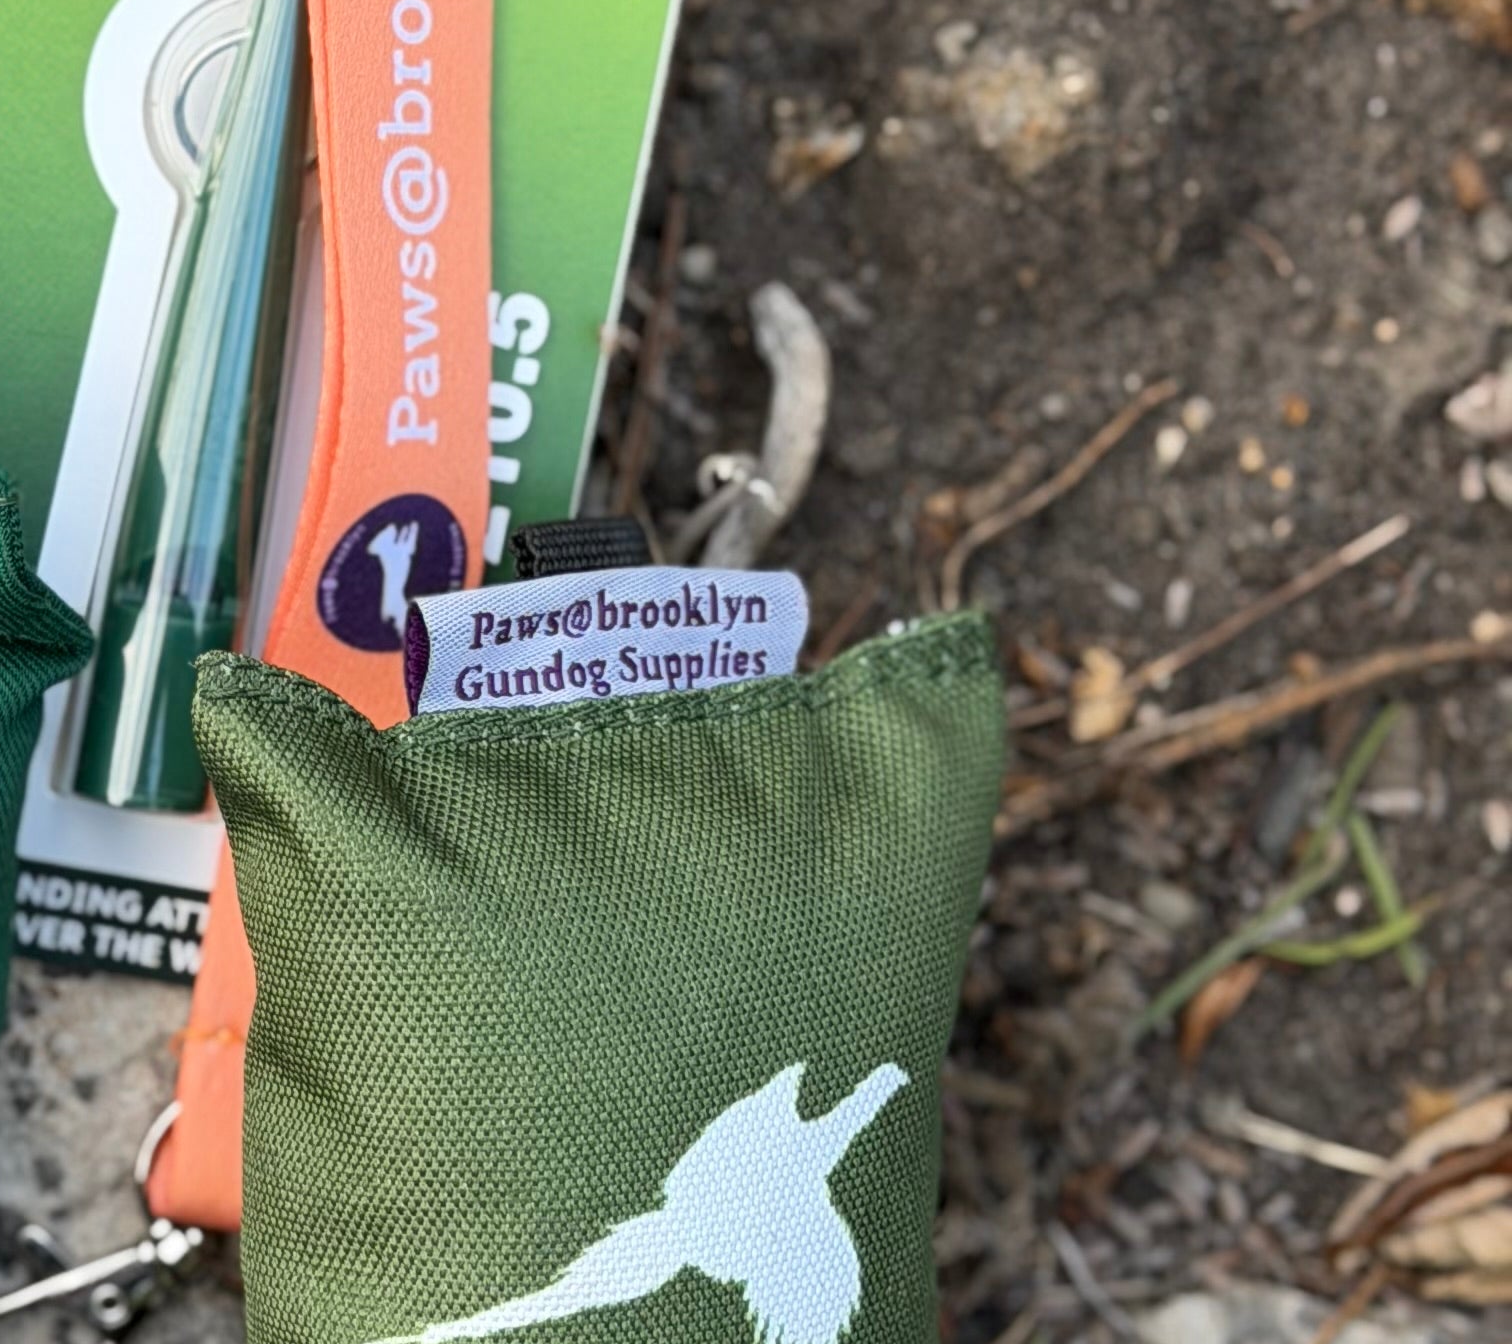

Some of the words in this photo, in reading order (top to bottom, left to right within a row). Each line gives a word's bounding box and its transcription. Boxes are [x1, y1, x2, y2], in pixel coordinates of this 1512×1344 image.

[468, 581, 768, 651] Paws@brooklyn
[454, 649, 612, 702] Gundog
[619, 638, 768, 690] Supplies
[91, 922, 165, 970] THE
